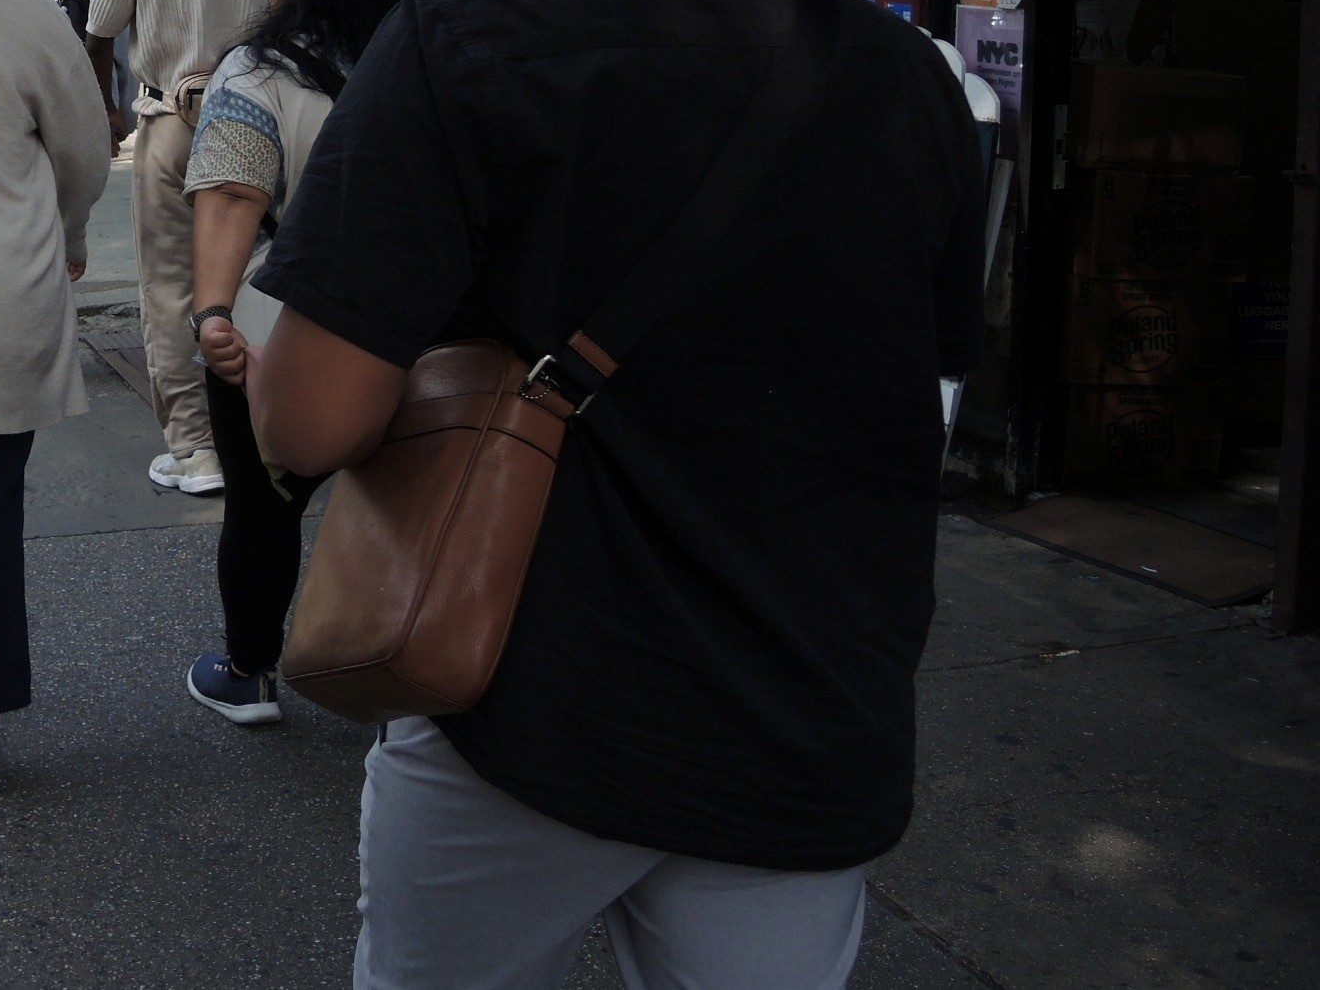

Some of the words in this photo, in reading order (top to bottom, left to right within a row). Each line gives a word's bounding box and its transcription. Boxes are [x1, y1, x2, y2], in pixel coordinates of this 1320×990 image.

[977, 39, 1019, 67] NYC
[998, 76, 1016, 88] Rights
[1264, 292, 1290, 302] YOU
[1238, 306, 1289, 317] LUGGAG
[1264, 320, 1289, 330] HER
